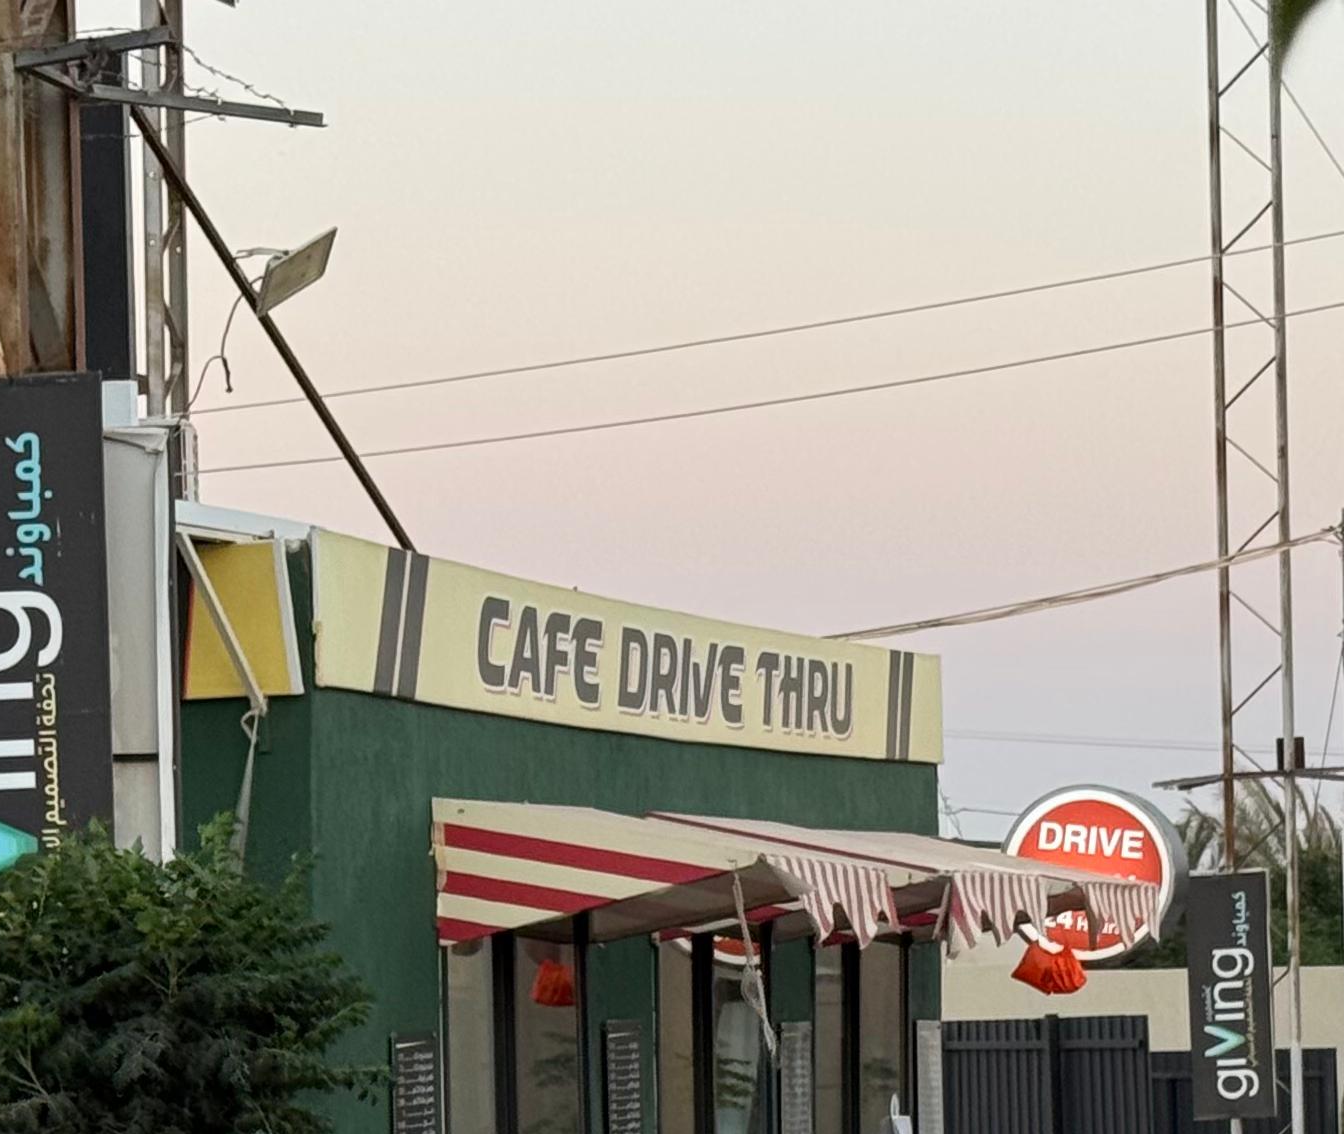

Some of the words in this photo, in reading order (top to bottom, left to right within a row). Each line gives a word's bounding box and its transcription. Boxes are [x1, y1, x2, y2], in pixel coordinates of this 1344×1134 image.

[5, 432, 53, 587] كمباوند
[35, 673, 57, 726] تحفة
[476, 595, 605, 710] CAFE
[616, 626, 746, 729] DRIVE
[756, 650, 855, 740] THRU
[38, 729, 68, 826] التصميم
[1038, 821, 1145, 860] DRIVE
